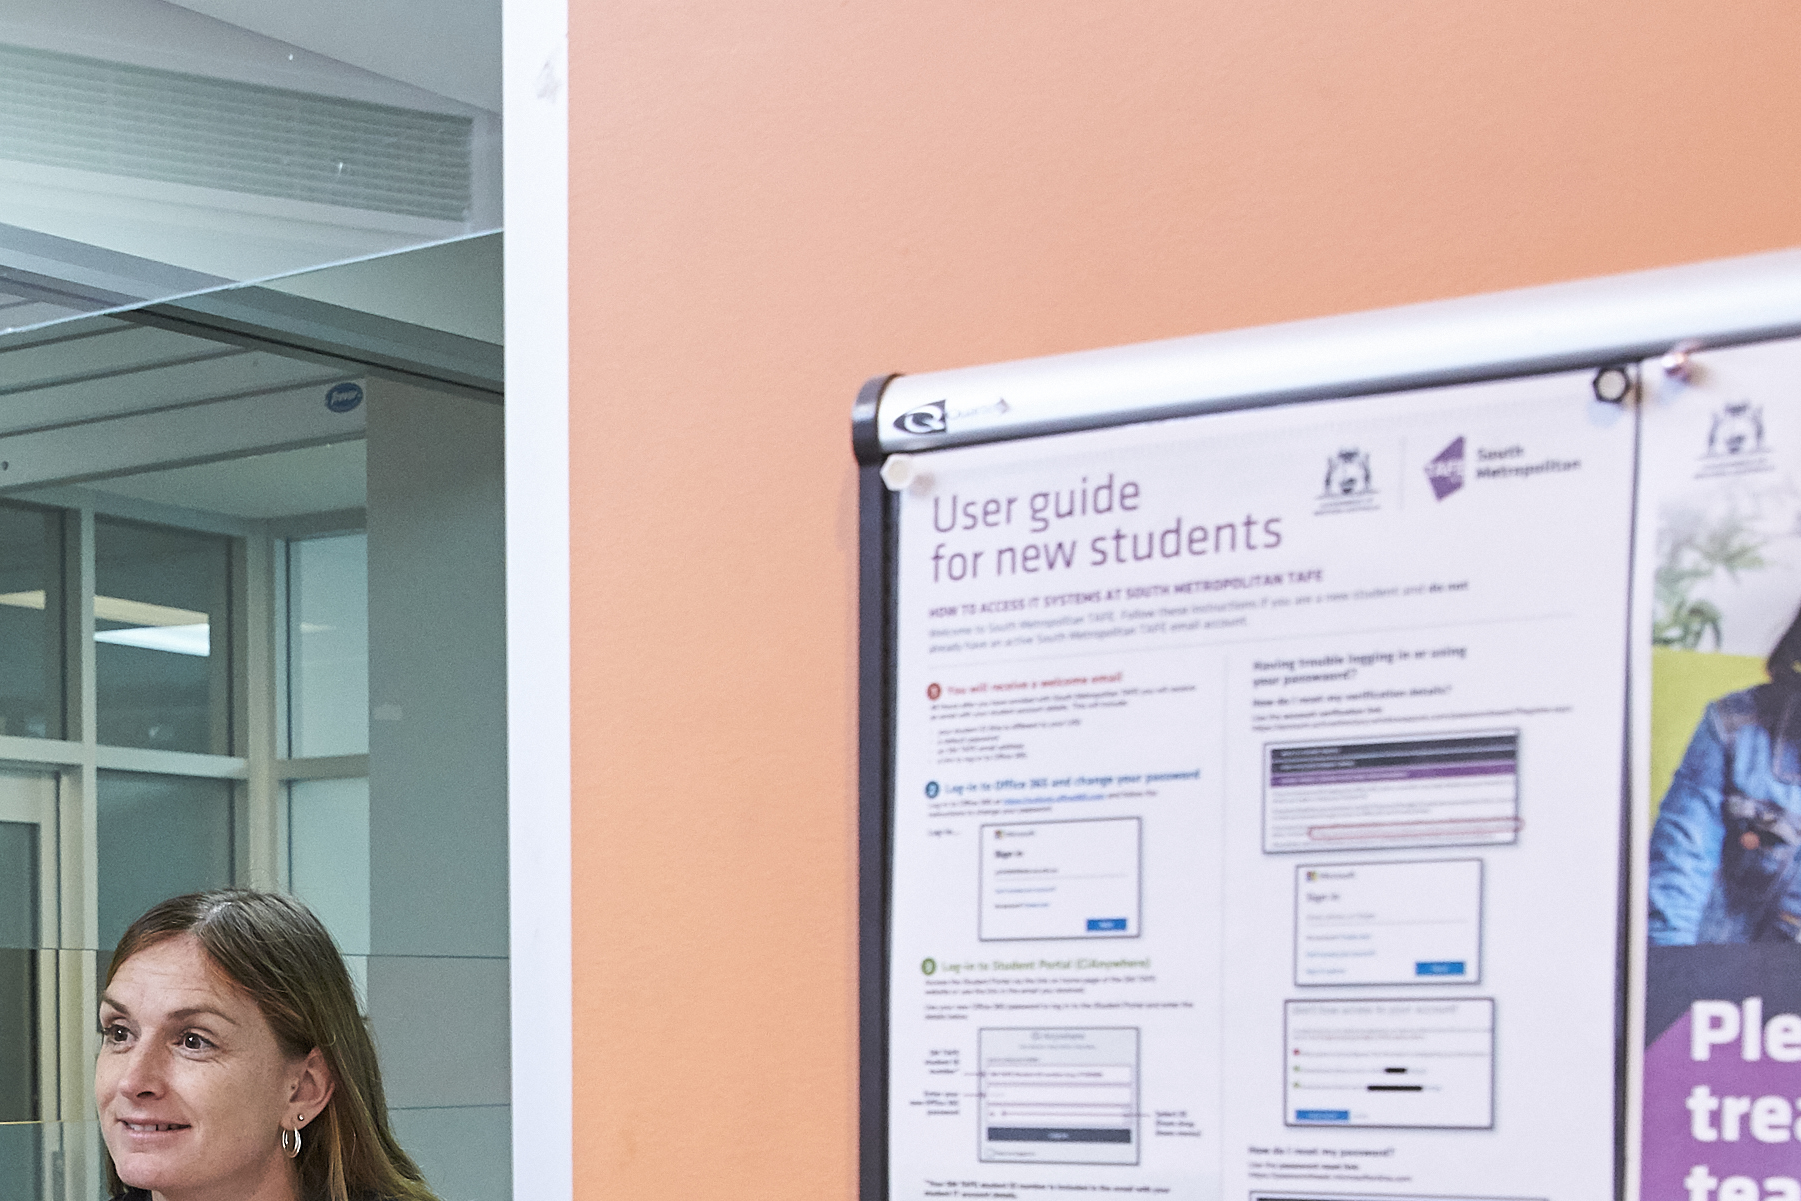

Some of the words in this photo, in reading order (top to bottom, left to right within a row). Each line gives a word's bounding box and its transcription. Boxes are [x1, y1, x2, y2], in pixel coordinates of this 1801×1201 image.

[1477, 445, 1524, 461] South
[1477, 460, 1581, 478] Metropolitan
[933, 495, 1017, 532] User
[1030, 473, 1140, 533] guide
[931, 543, 983, 582] for
[997, 540, 1076, 576] new
[1091, 514, 1282, 567] students
[929, 606, 957, 617] HOW
[962, 604, 975, 615] TO
[981, 598, 1025, 613] ACCESS
[1027, 596, 1040, 608] IT
[1044, 591, 1101, 607] SYSTEMS
[1105, 589, 1121, 600] AT
[1125, 584, 1169, 599] SOUTH
[1173, 573, 1283, 594] METROPOLITAN
[1287, 569, 1322, 583] TAFE
[1685, 1085, 1801, 1143] tre
